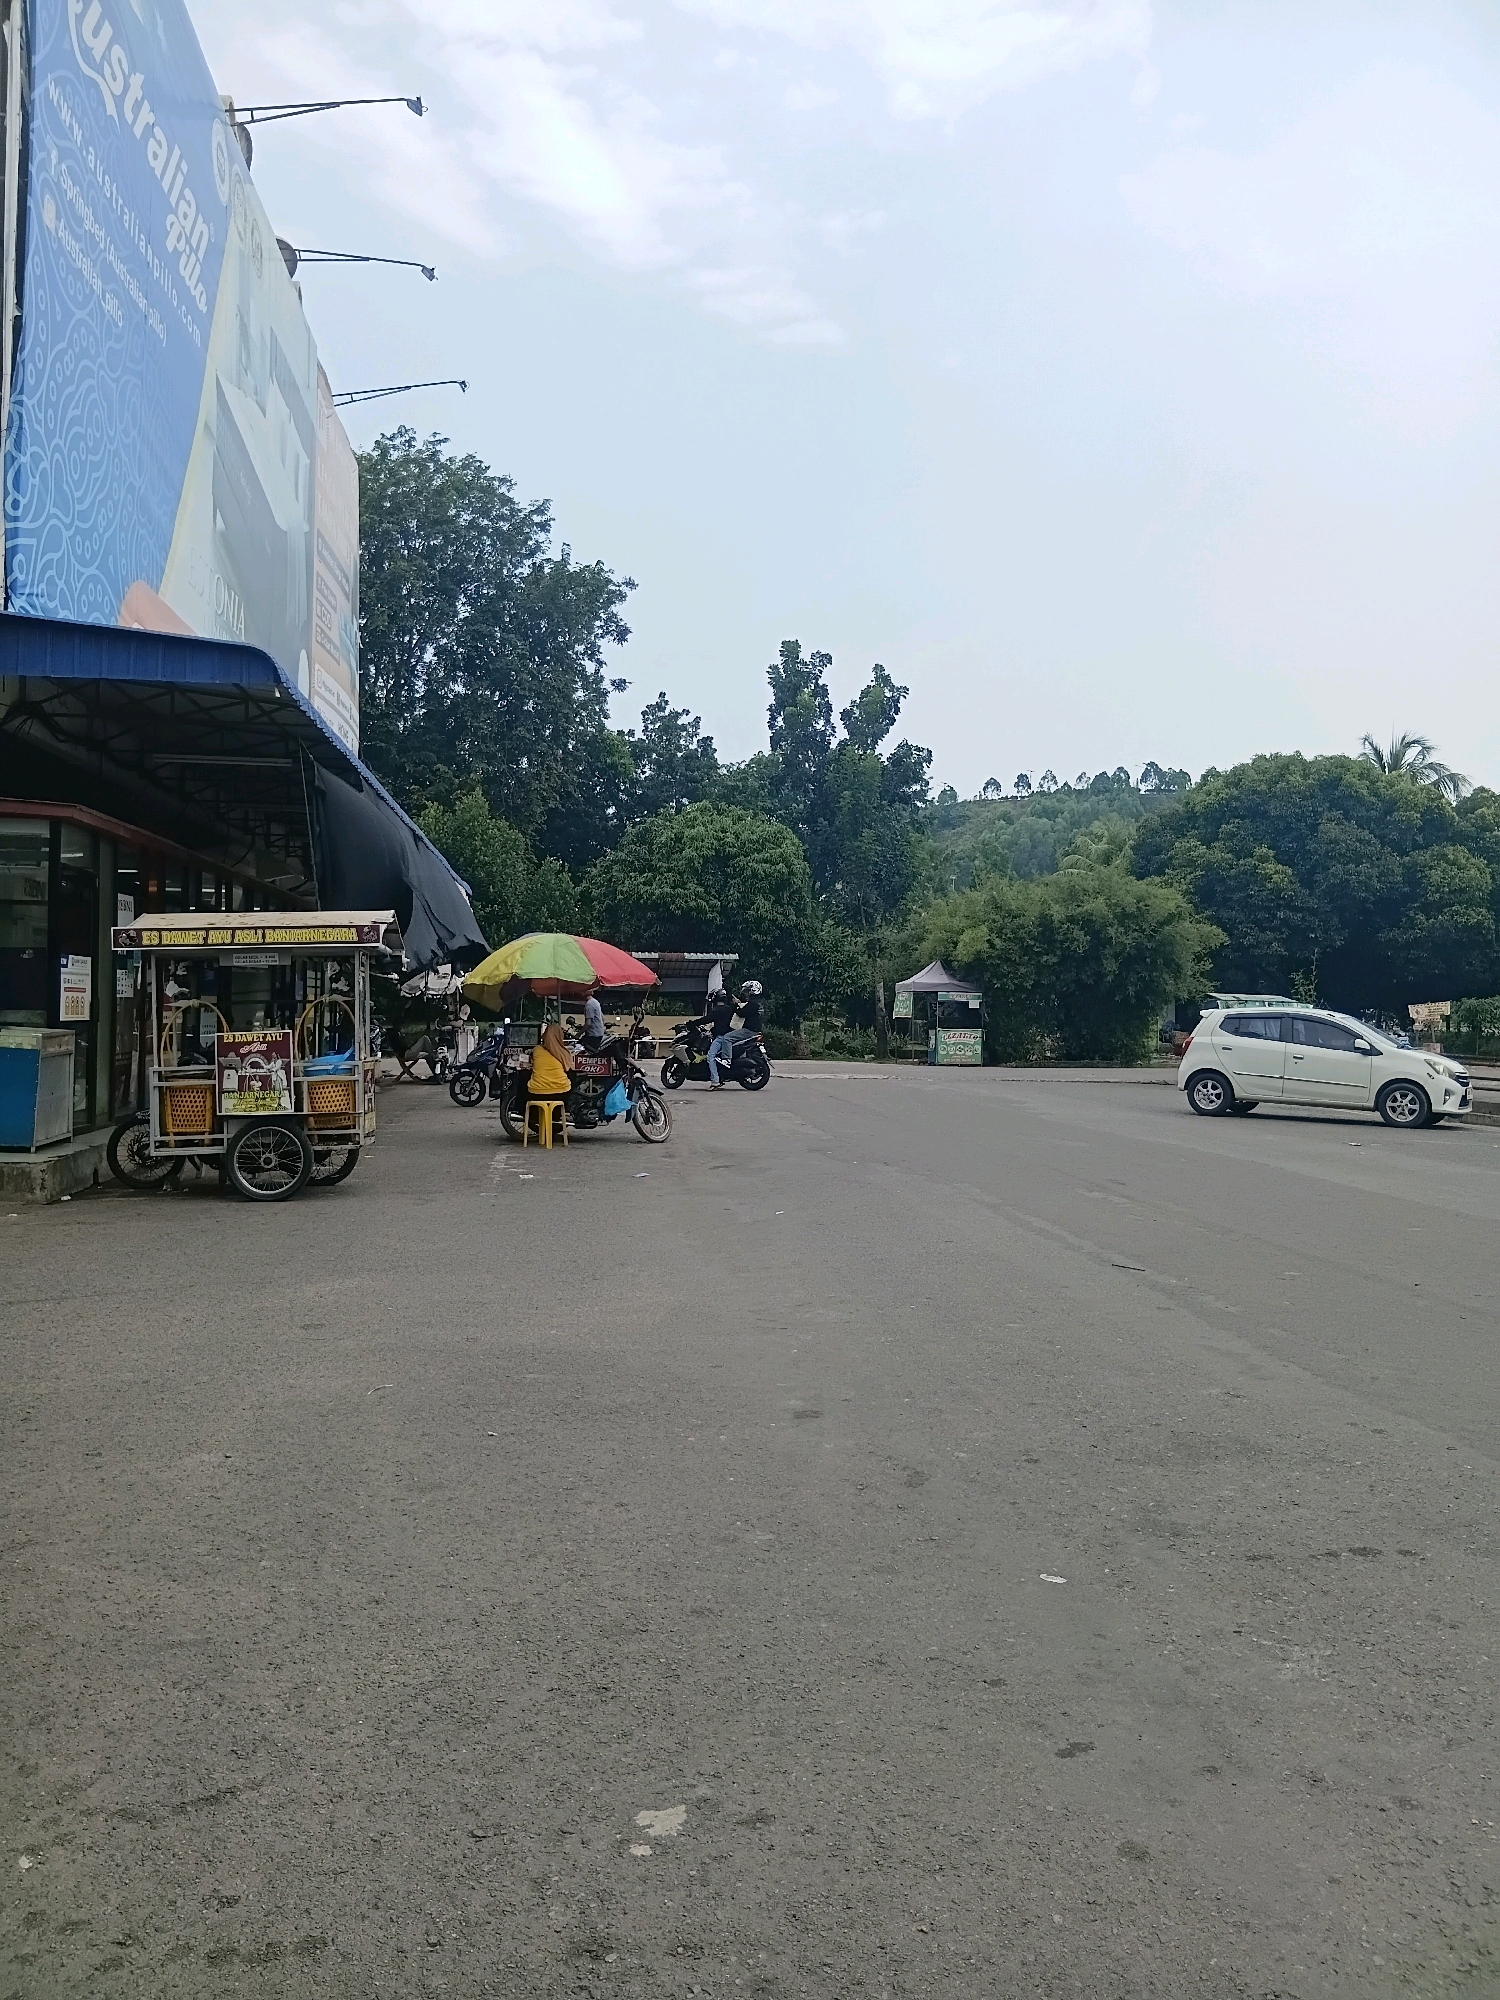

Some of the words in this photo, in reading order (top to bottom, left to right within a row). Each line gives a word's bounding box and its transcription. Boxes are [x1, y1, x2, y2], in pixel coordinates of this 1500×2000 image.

[67, 0, 210, 263] ustralian
[49, 76, 201, 348] www.australianpillo.com
[58, 218, 124, 328] Australian_pillo
[61, 163, 105, 250] Springbed
[106, 236, 148, 316] (Australian
[149, 306, 168, 348] pillo)
[142, 931, 160, 945] ES
[161, 930, 207, 945] DAWET
[208, 929, 232, 944] AYU
[234, 929, 263, 944] ASLI
[265, 927, 359, 943] BANJARNEGARA
[225, 1091, 286, 1099] BANJARNEGARA
